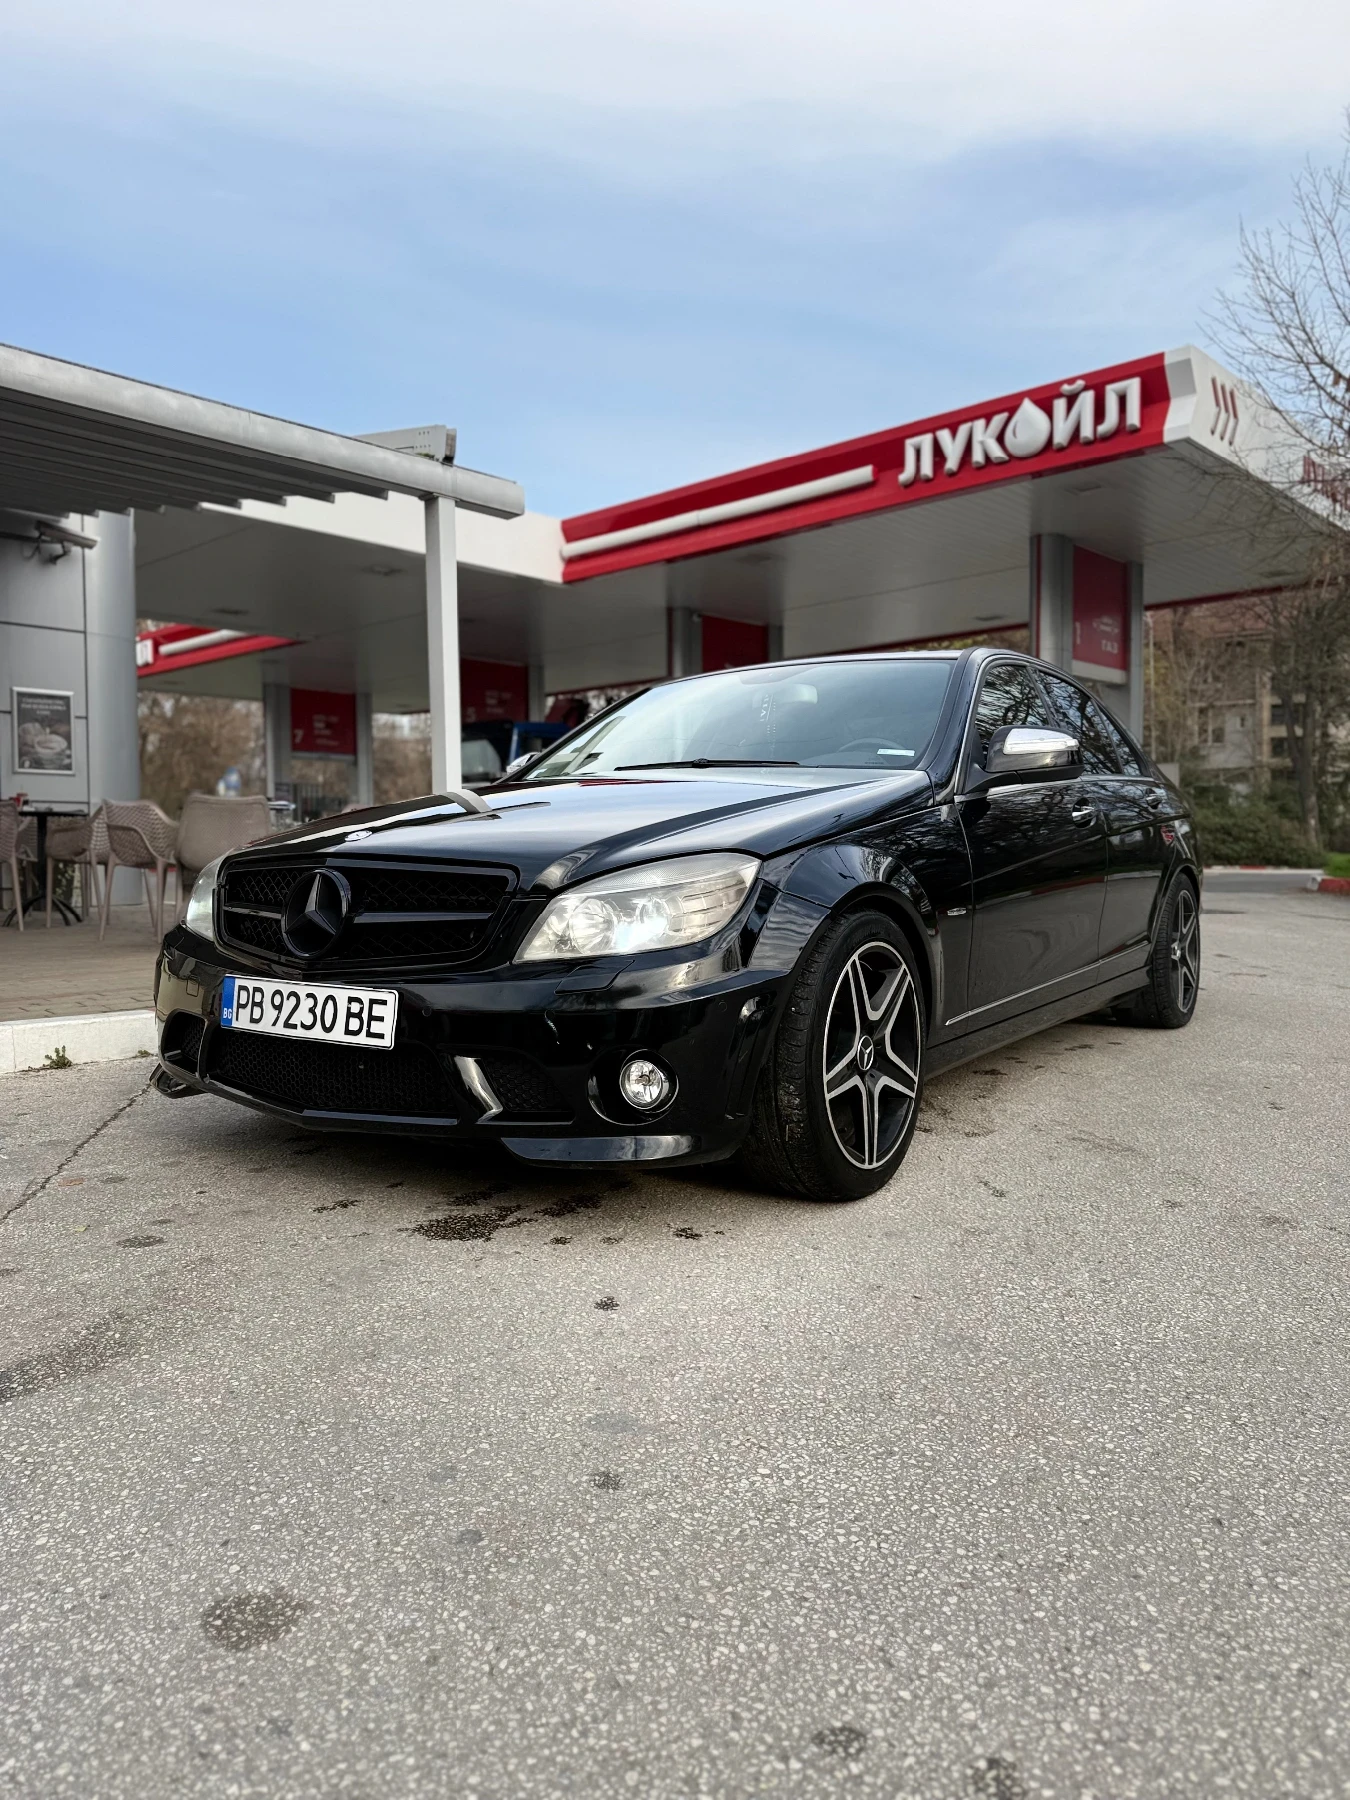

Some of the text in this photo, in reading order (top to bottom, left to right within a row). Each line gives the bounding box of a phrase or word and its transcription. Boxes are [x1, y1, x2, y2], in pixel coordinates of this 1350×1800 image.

[898, 376, 1141, 487] ЛУКОЙЛ
[222, 1007, 233, 1020] BG
[235, 984, 388, 1040] PB 9230 BE
